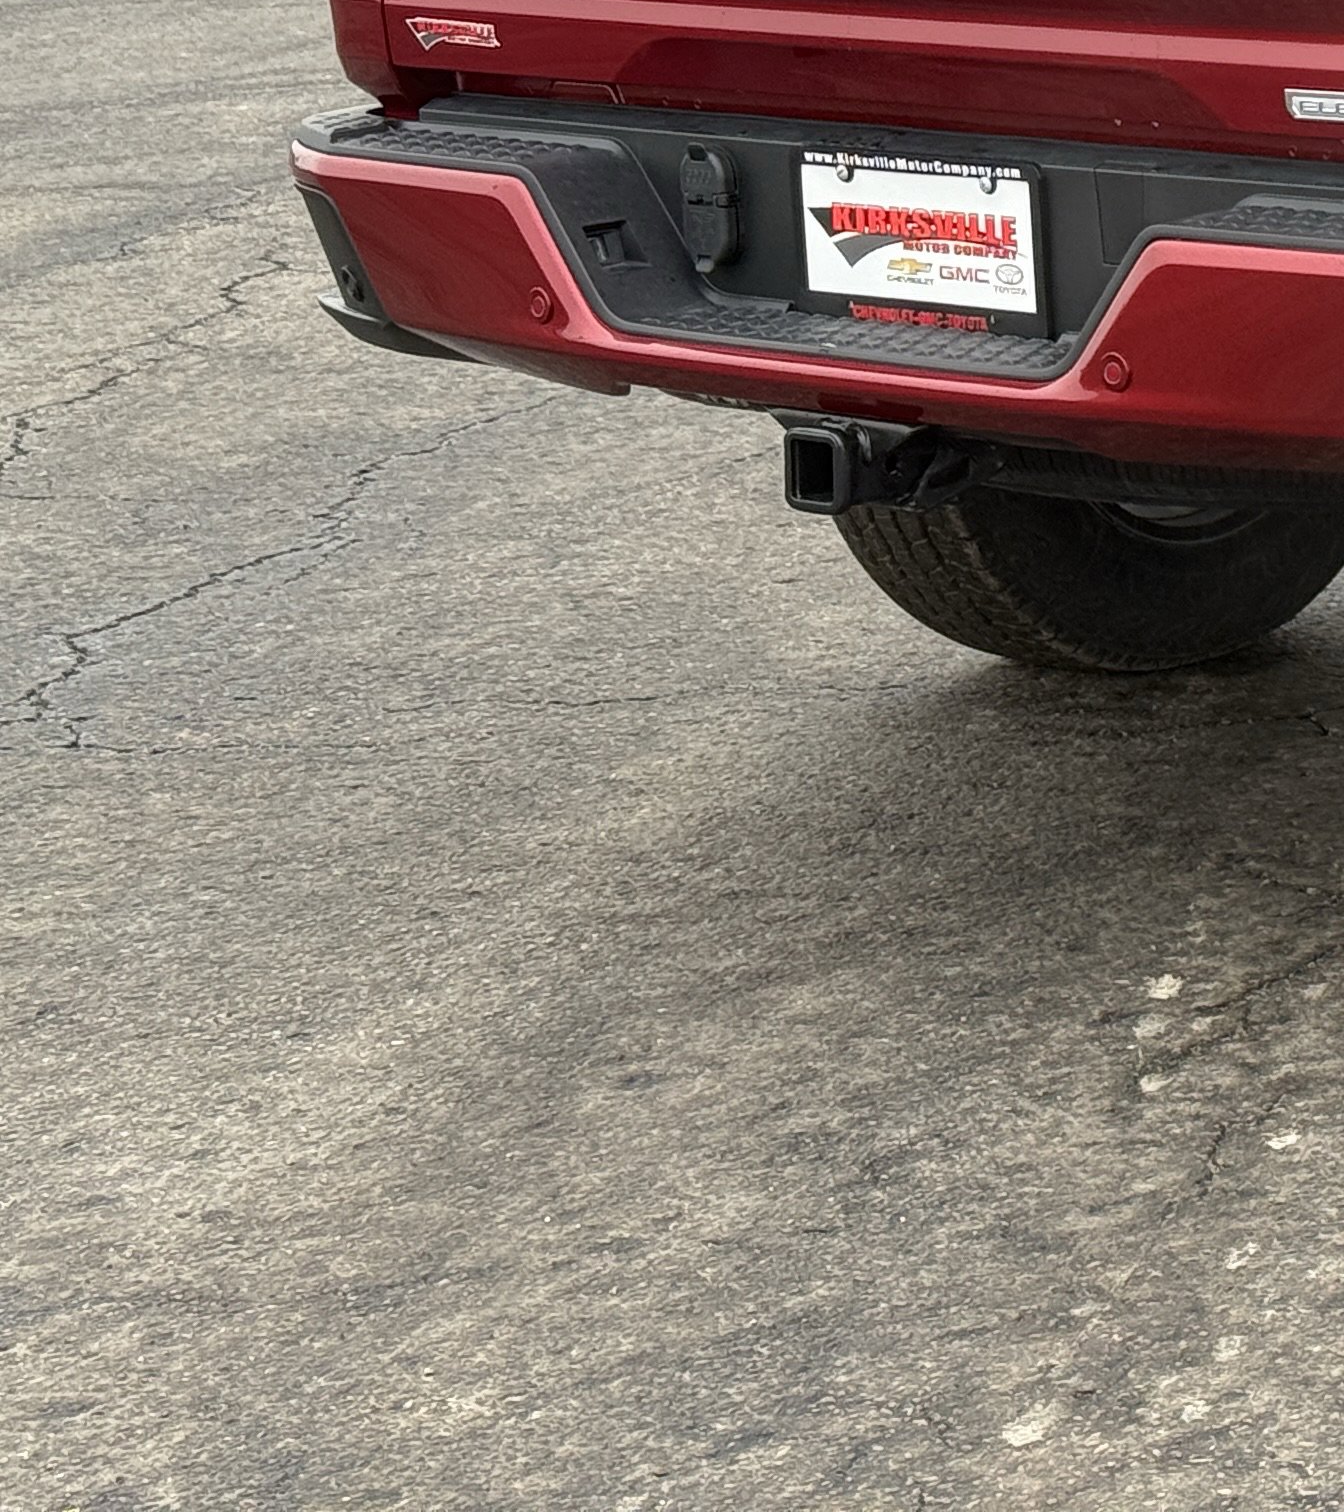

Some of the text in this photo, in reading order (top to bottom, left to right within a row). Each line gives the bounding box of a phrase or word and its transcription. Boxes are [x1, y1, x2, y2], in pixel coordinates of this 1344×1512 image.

[803, 151, 1022, 179] www.KirksvilleMotorCompany.com
[830, 201, 1018, 245] KIRKSVILLE
[902, 240, 1019, 261] MOTOR COMPANY
[939, 265, 991, 285] GMC
